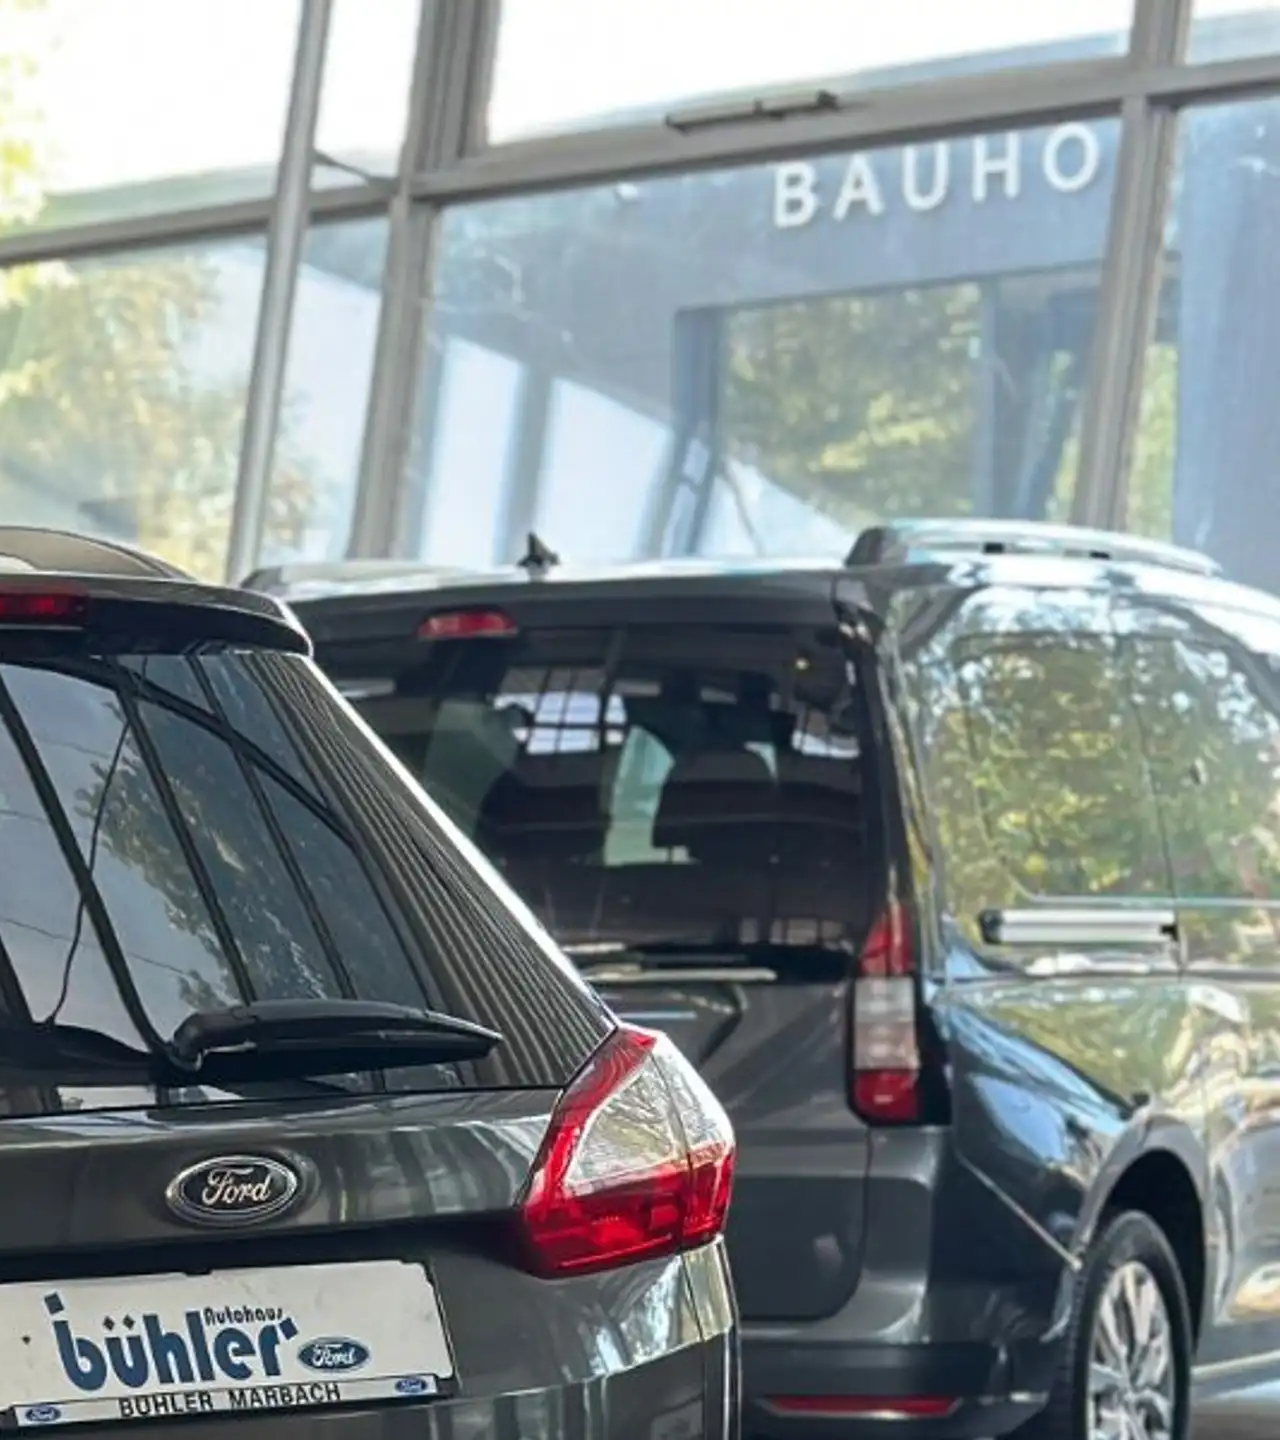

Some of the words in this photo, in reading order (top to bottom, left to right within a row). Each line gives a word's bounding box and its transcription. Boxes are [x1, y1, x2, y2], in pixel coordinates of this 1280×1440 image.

[773, 121, 1099, 228] BAUHO
[201, 1166, 272, 1206] Ford
[43, 1292, 299, 1392] bühler
